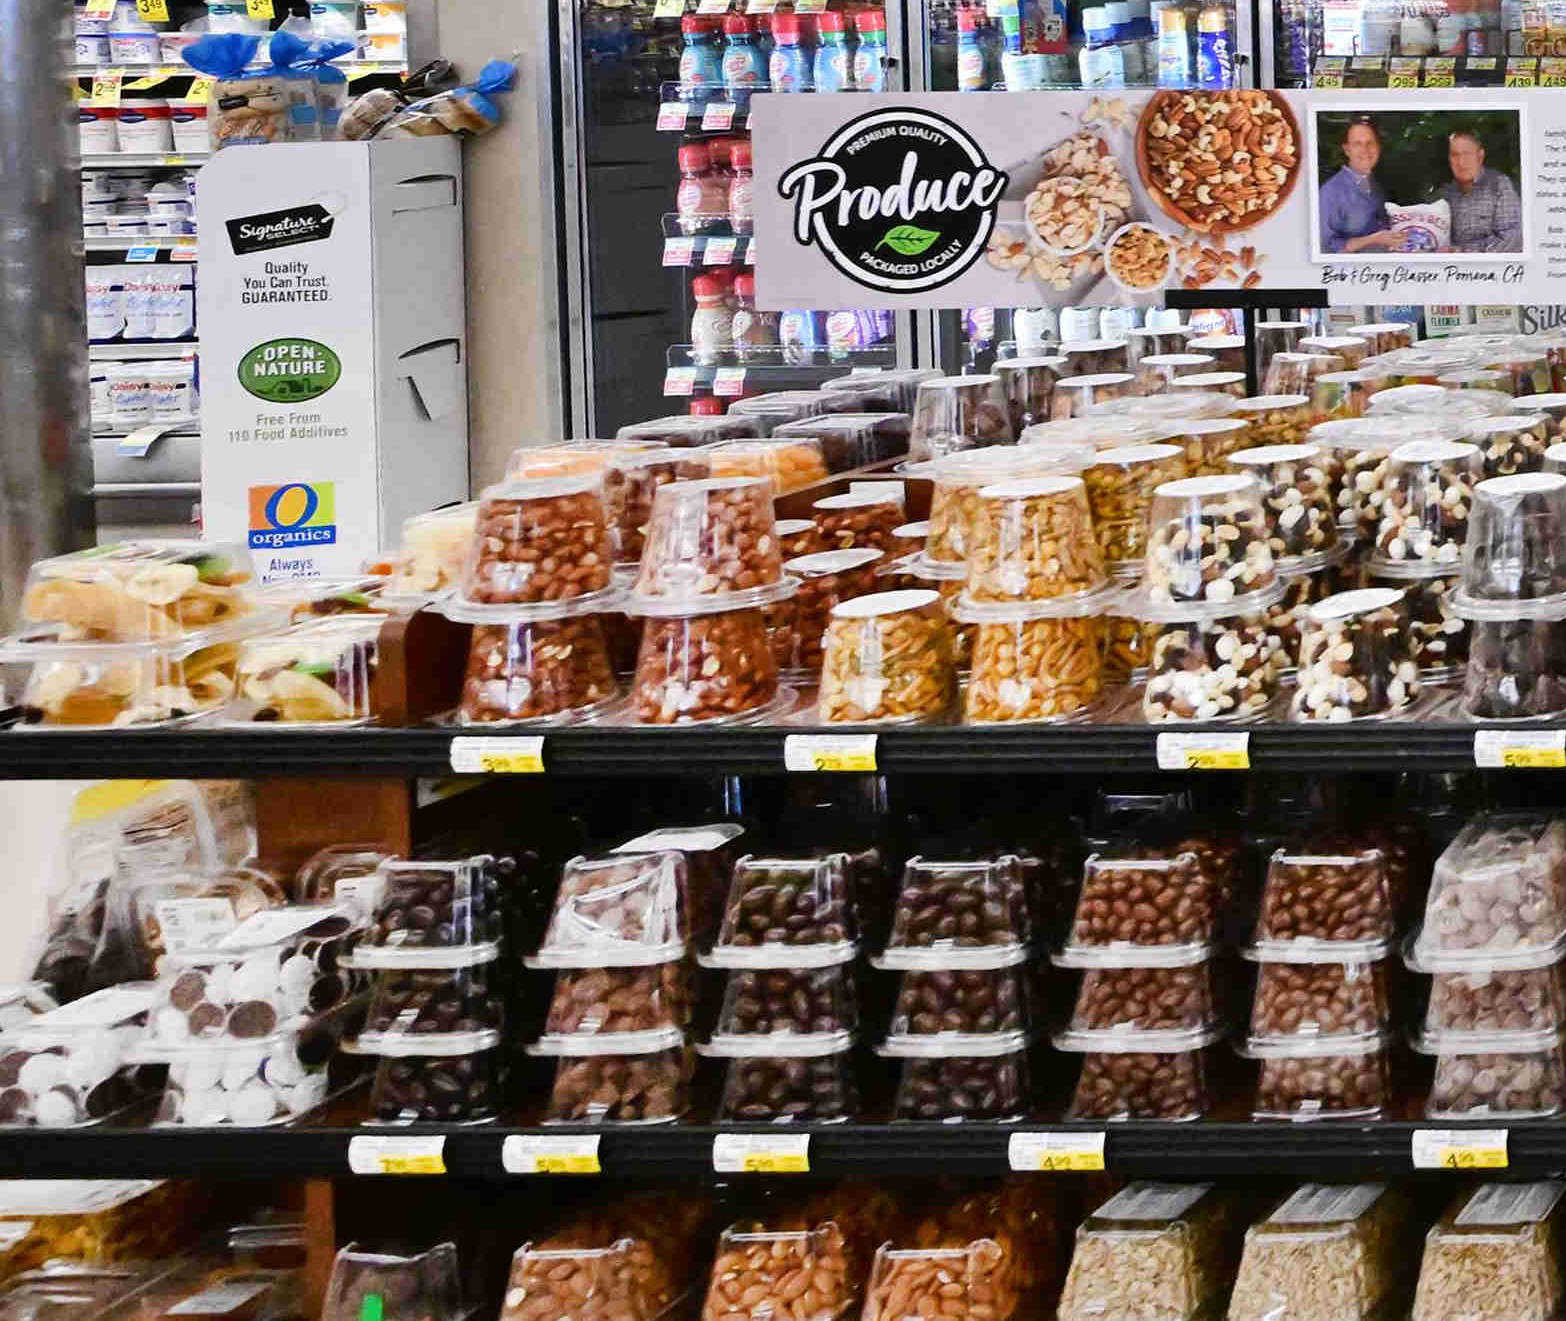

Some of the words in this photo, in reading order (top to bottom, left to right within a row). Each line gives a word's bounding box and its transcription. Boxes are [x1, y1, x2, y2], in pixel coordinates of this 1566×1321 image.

[847, 126, 896, 155] PREMIUM
[899, 124, 949, 147] QUALITY
[781, 150, 1006, 242] Produce
[238, 216, 317, 241] Signature
[858, 251, 919, 275] PACKAGED
[919, 239, 964, 273] LOCALLY
[264, 261, 309, 276] Quality
[243, 277, 267, 289] You
[269, 276, 293, 288] Can
[1320, 265, 1346, 285] Bob
[1359, 266, 1391, 291] Greg
[1502, 265, 1525, 283] CA
[263, 345, 316, 362] OPEN
[253, 360, 326, 377] NATURE
[255, 413, 286, 426] Free
[288, 412, 321, 425] From
[254, 428, 286, 441] Food
[289, 425, 349, 439] Additives
[264, 482, 319, 529] O
[251, 528, 332, 547] organics
[269, 557, 314, 572] Always
